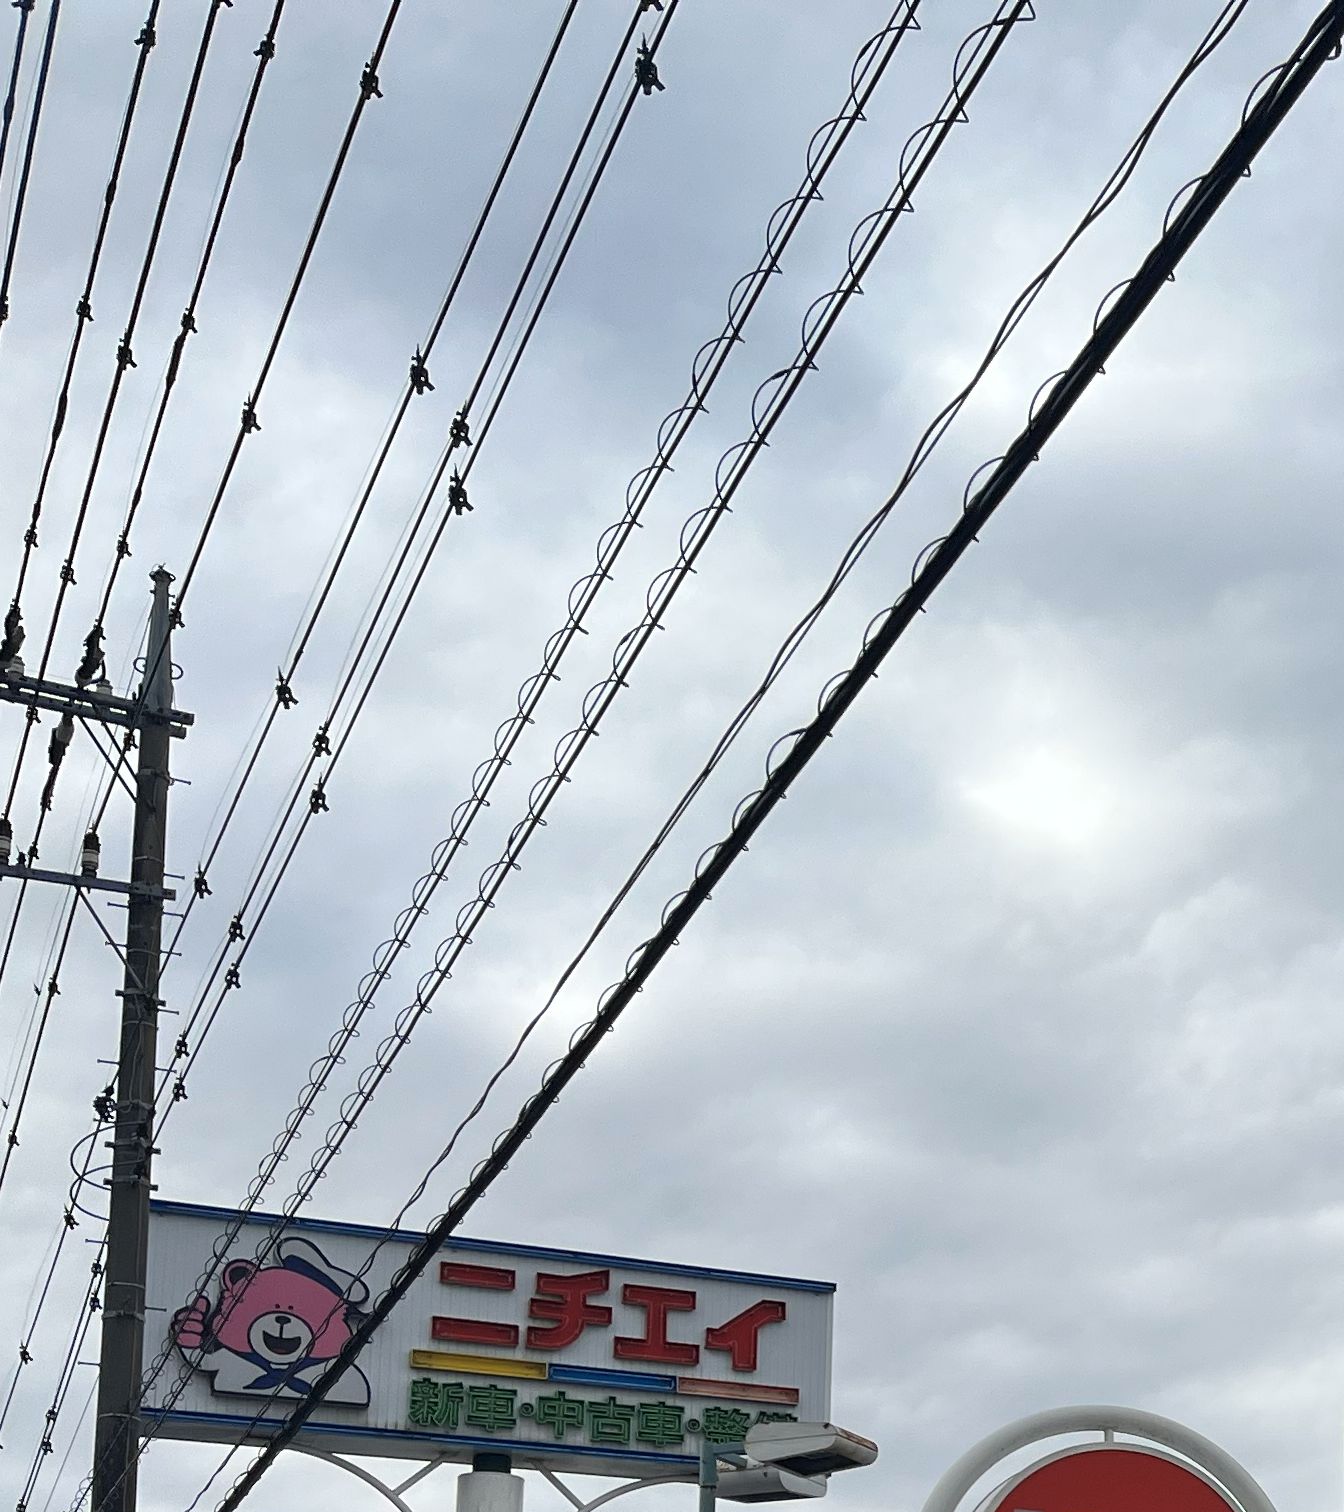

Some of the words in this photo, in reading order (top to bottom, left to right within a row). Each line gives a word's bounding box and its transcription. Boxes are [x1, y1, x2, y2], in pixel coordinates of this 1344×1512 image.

[430, 1260, 788, 1373] ニチエイ
[408, 1376, 799, 1450] 新車・中古車・整
